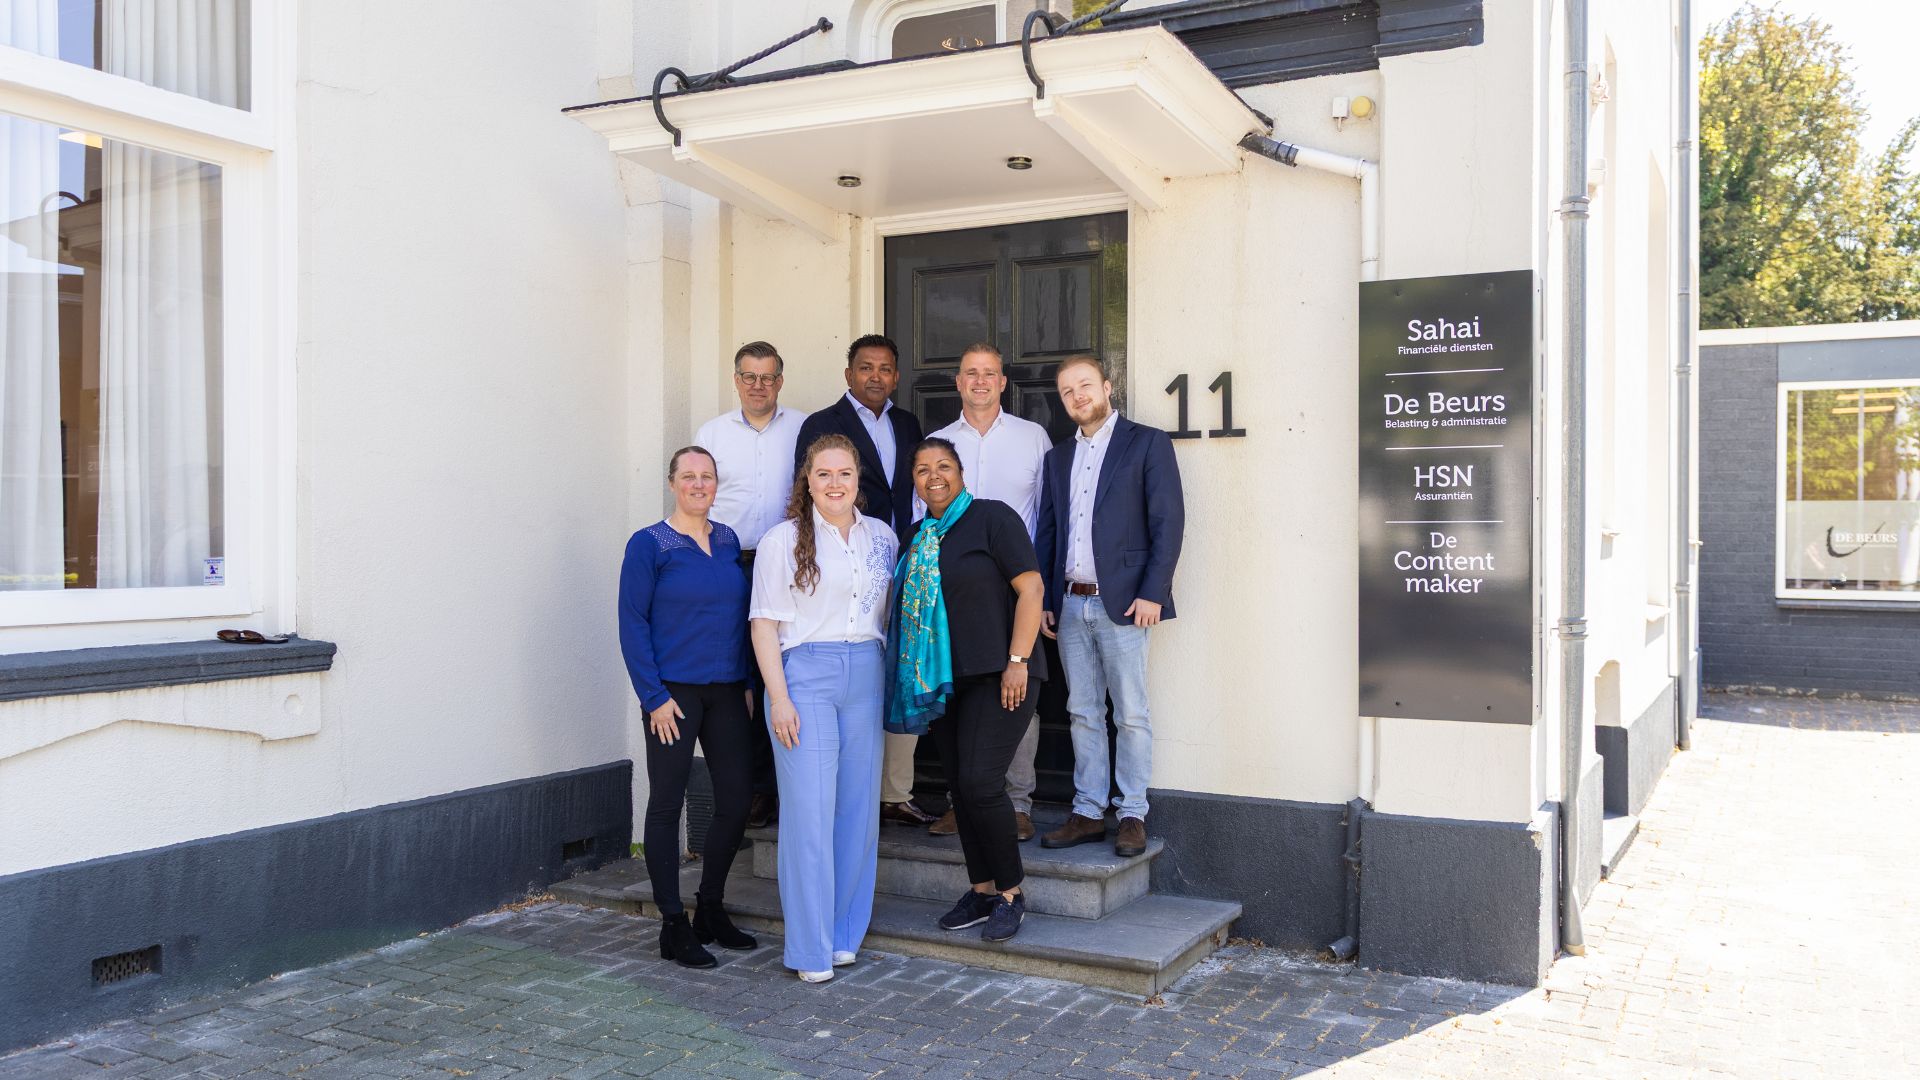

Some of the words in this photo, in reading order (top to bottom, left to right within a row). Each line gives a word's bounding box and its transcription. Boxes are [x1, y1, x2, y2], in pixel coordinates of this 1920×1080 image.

[1407, 316, 1481, 341] Sahai
[1398, 344, 1448, 355] Financiële
[1450, 343, 1493, 352] diensten
[1165, 371, 1246, 439] 11
[1384, 393, 1420, 415] De
[1428, 392, 1506, 414] Beurs
[1385, 419, 1429, 430] Belasting
[1432, 418, 1439, 427] &
[1441, 416, 1507, 427] administratie
[1414, 465, 1474, 488] HSN
[1415, 492, 1473, 501] Assurantiën
[1430, 532, 1457, 548] De
[1835, 533, 1853, 543] DE
[1856, 533, 1898, 543] BEURS
[1394, 550, 1495, 571] Content
[1405, 573, 1483, 593] maker
